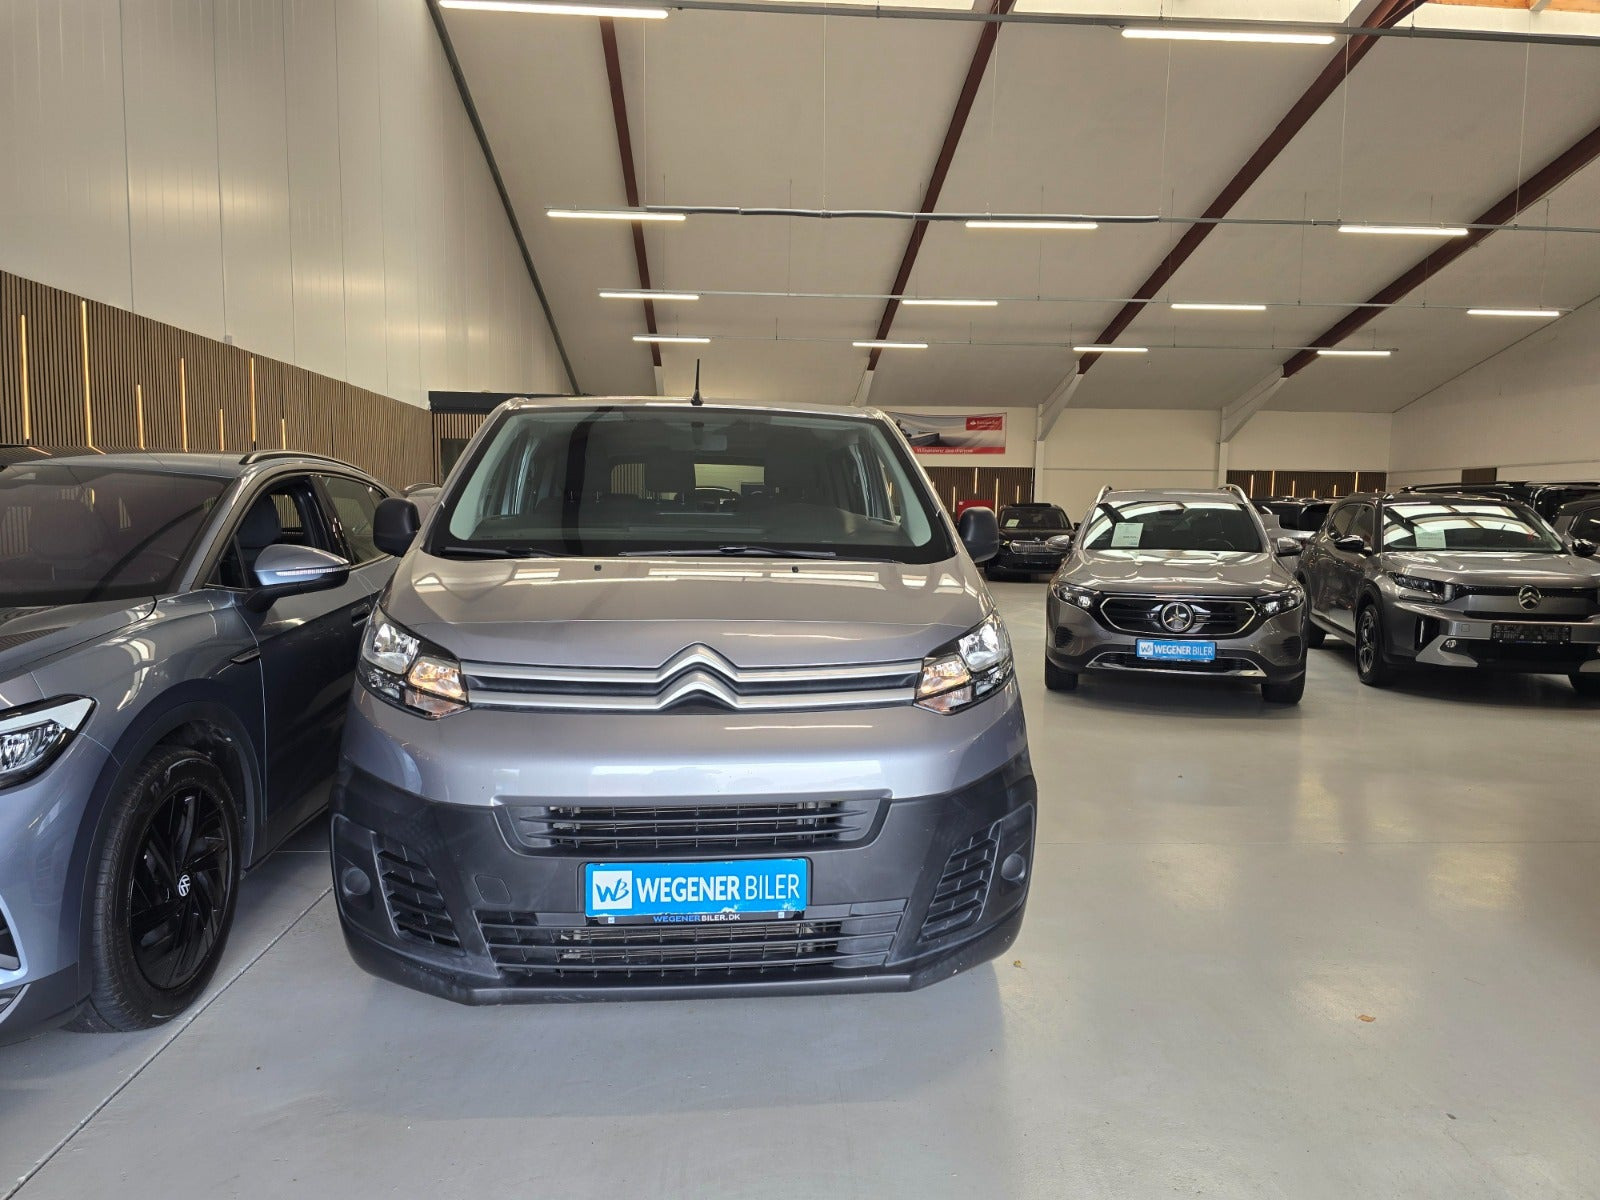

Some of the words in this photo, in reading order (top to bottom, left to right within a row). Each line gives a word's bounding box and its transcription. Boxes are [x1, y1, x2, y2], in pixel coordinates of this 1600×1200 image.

[1154, 645, 1192, 655] WEGENER
[1192, 646, 1213, 656] BILER
[636, 876, 741, 903] WEGENER
[745, 874, 800, 900] BILER
[653, 913, 741, 923] WEGENERBILER.DK
